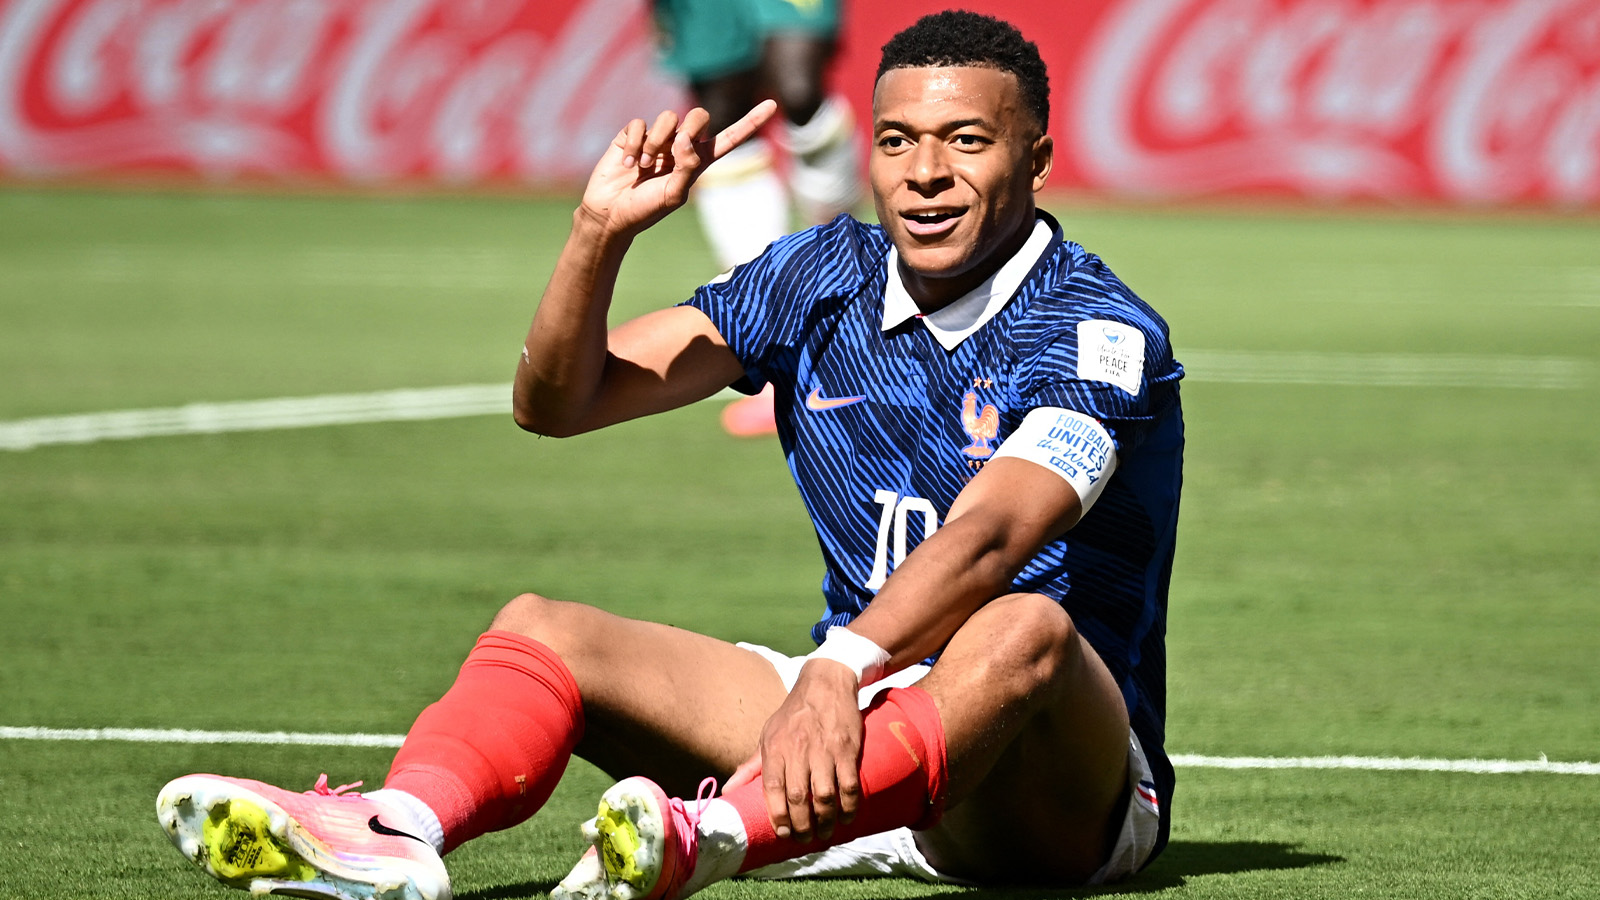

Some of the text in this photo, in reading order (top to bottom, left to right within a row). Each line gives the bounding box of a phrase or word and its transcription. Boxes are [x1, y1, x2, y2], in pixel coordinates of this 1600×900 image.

[1099, 354, 1128, 373] PEACE
[1047, 426, 1106, 472] UNITES
[1055, 413, 1110, 460] FOOTBALL
[1036, 439, 1100, 486] the World
[1049, 455, 1078, 479] FIFA
[864, 489, 938, 590] 10
